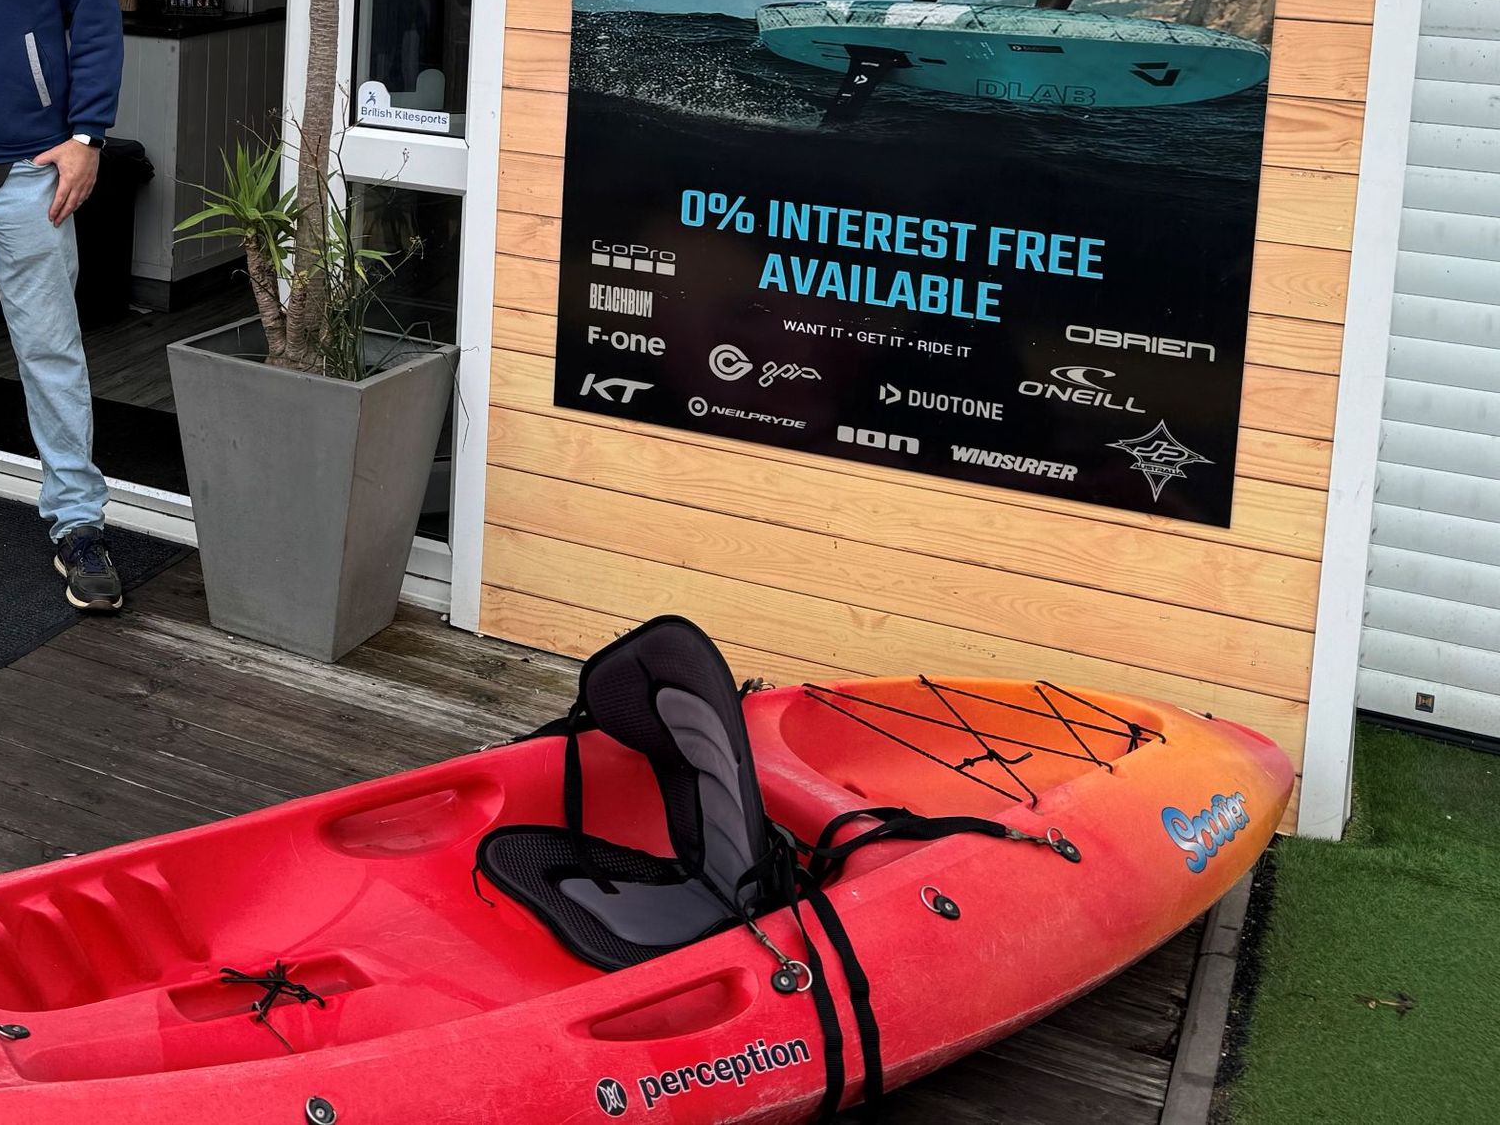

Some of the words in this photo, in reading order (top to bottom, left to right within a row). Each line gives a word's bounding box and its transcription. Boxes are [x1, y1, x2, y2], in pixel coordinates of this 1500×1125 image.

[976, 78, 1096, 107] DLAB
[361, 106, 392, 119] British
[395, 110, 448, 125] Kitesports
[591, 239, 676, 263] GoPro
[681, 189, 755, 234] 0%
[767, 200, 977, 262] INTEREST
[988, 226, 1106, 280] FREE
[589, 282, 653, 319] BEACHBUM
[758, 253, 1003, 323] AVAILABLE
[783, 320, 827, 336] WANT
[831, 327, 845, 339] IT
[857, 331, 886, 345] GET
[890, 336, 905, 348] IT
[917, 340, 953, 356] RIDE
[957, 346, 972, 358] IT
[579, 373, 655, 404] KT
[908, 389, 1004, 421] DUOTONE
[1018, 380, 1146, 414] O'NEILL
[711, 405, 808, 429] NEILPRYDE
[951, 444, 1079, 482] WINDSURFER
[638, 1038, 811, 1110] perception
